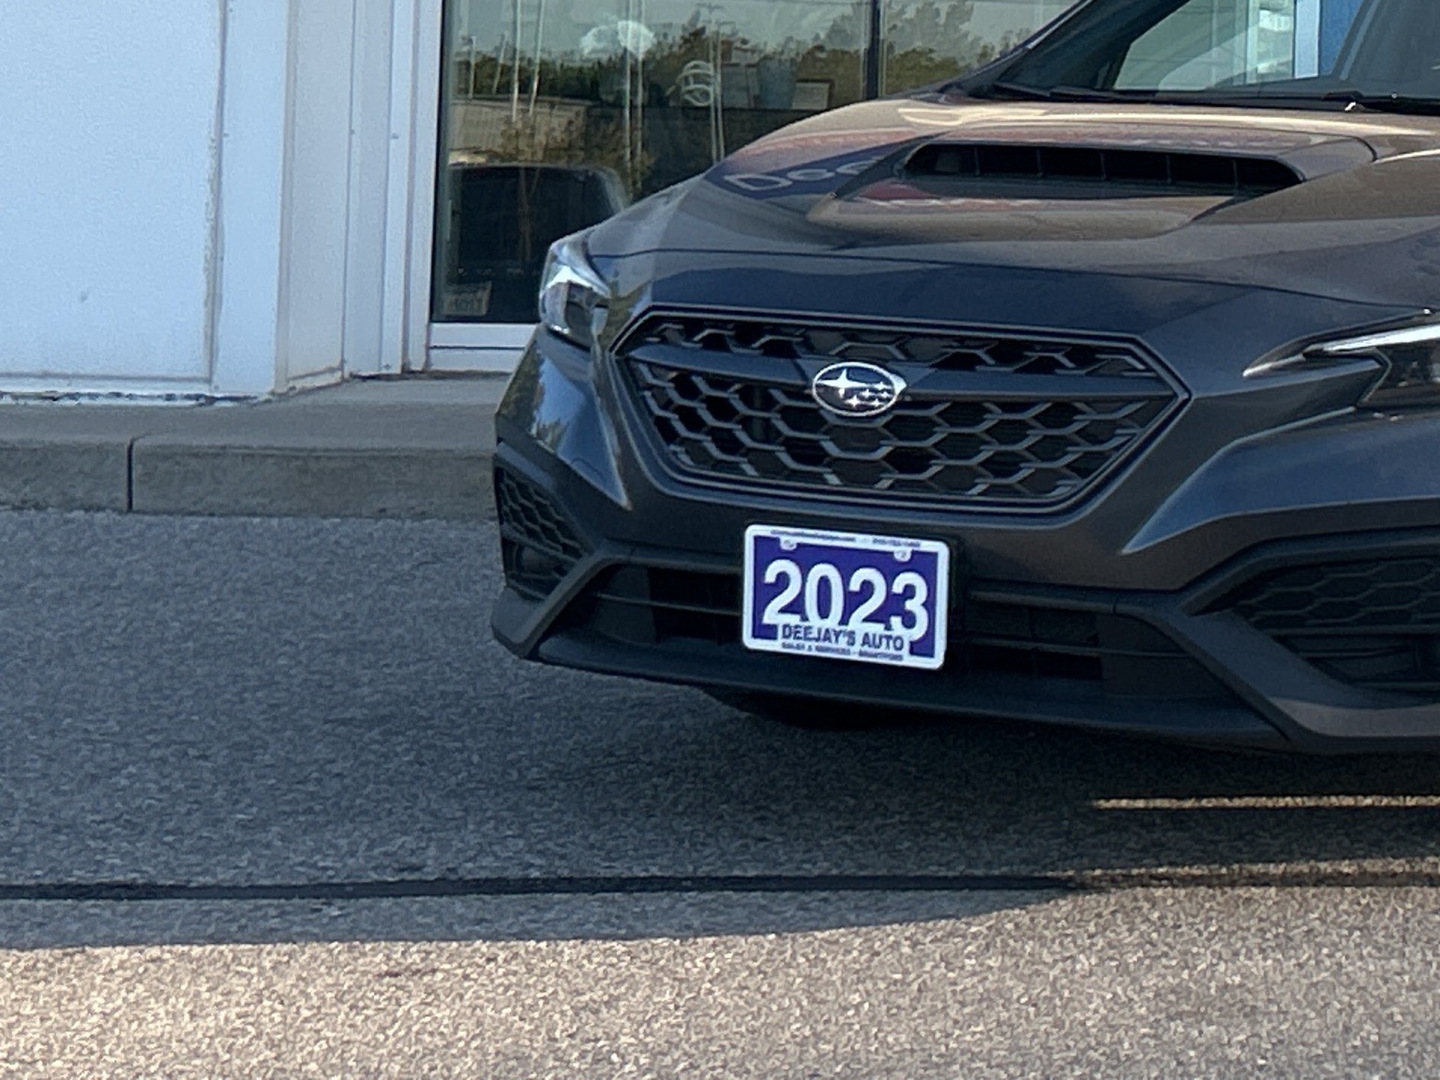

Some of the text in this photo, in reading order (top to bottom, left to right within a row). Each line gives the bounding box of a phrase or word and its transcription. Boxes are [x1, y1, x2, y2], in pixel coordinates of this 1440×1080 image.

[762, 559, 928, 641] 2023
[782, 624, 856, 646] DEEJAY'S
[860, 632, 904, 651] AUTO
